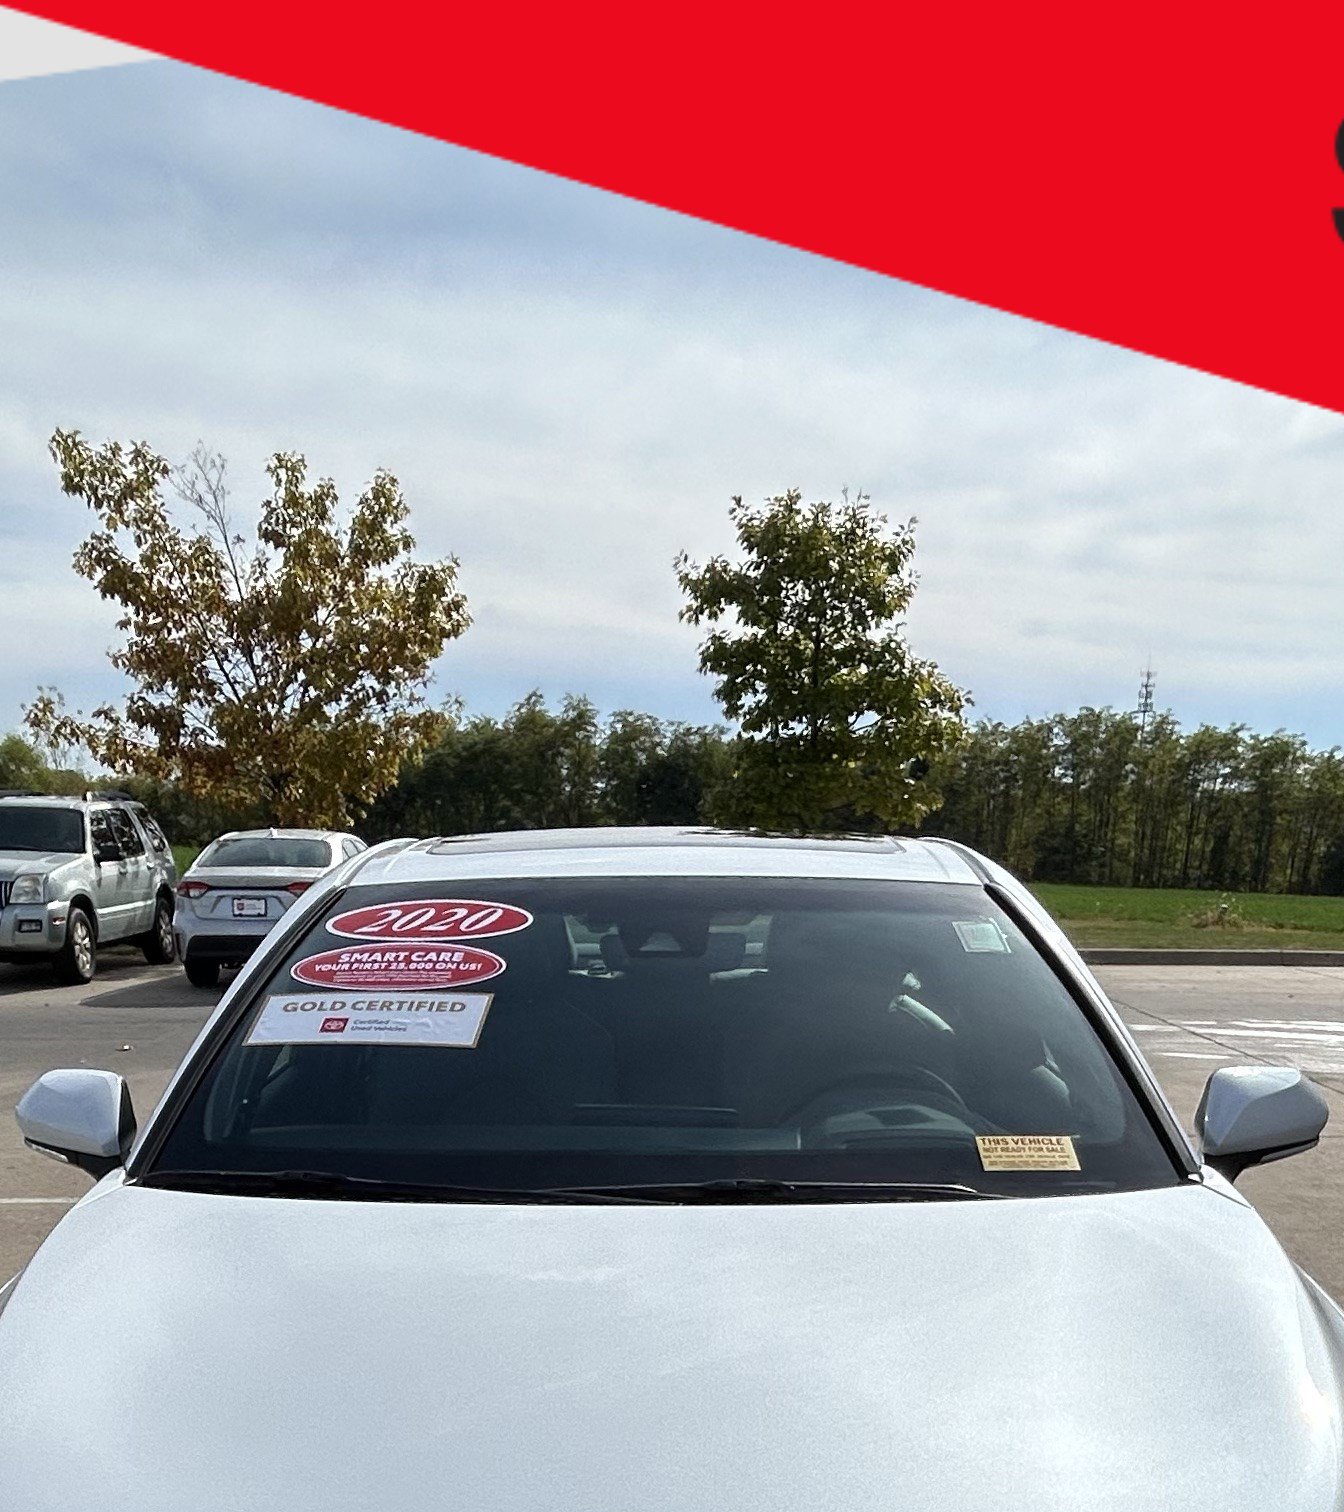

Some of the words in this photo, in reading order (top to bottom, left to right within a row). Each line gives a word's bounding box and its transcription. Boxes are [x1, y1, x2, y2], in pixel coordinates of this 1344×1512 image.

[354, 907, 504, 933] 2020
[338, 952, 408, 962] SMART
[410, 951, 465, 962] CARE
[314, 963, 349, 972] YOUR
[351, 962, 388, 970] FIRST
[435, 962, 456, 970] ON
[458, 962, 483, 971] US!
[282, 1000, 347, 1013] GOLD
[351, 1000, 467, 1013] CERTIFIED
[980, 1138, 1009, 1146] THIS
[1011, 1137, 1065, 1146] VEHICLE
